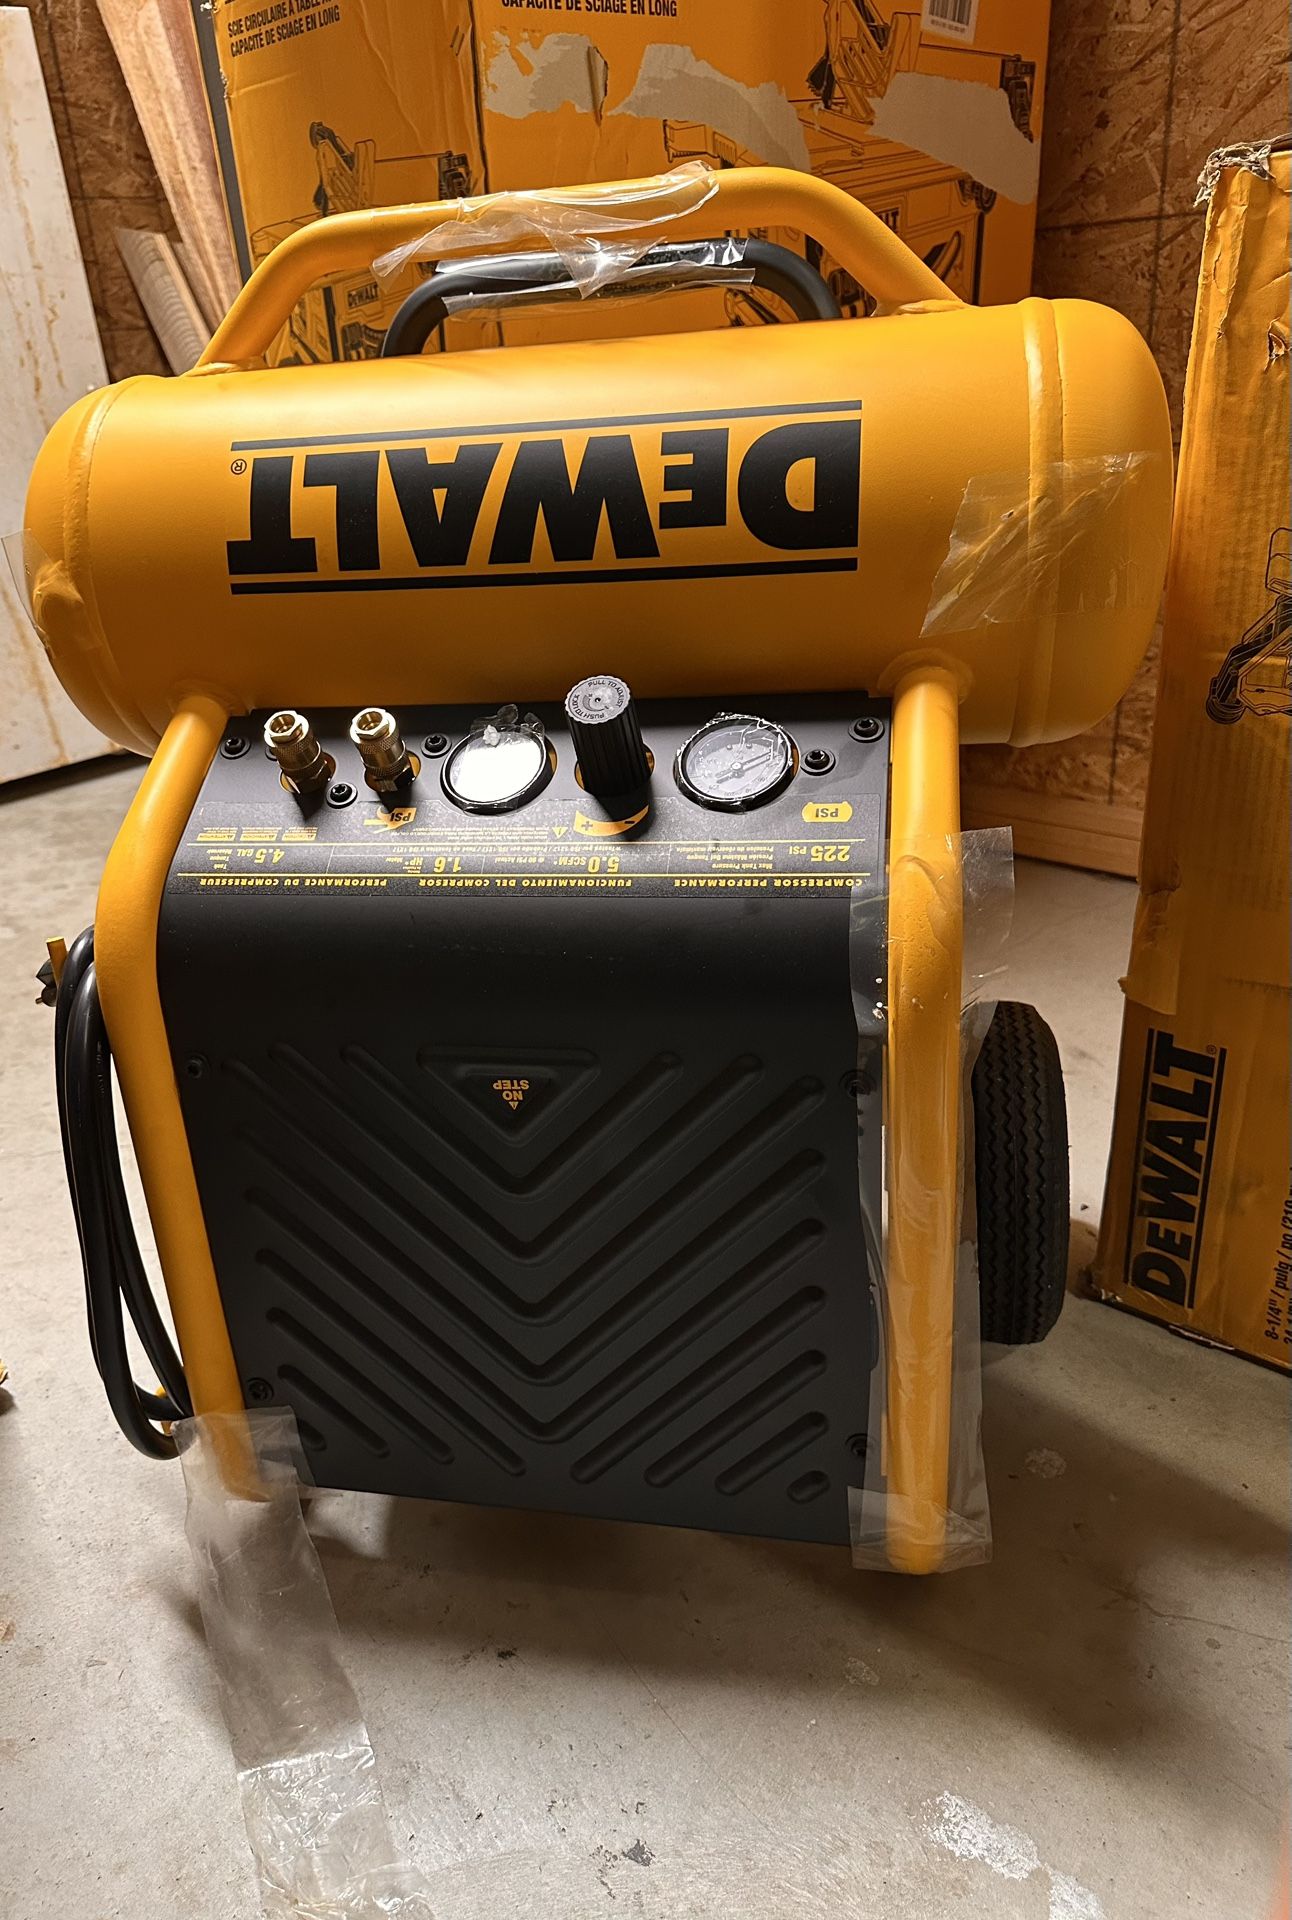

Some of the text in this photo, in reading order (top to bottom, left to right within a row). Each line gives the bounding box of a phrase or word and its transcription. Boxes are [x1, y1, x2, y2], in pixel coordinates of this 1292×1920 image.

[585, 0, 627, 14] SCIAGE
[630, 0, 645, 15] EN
[648, 0, 677, 17] LONG
[228, 18, 244, 38] SCIE
[244, 2, 287, 32] CIRCULAIRE
[230, 4, 340, 57] CAPACITÉ DE SCIAGE EN LONG
[226, 418, 861, 576] DEWALT
[587, 679, 606, 688] PULL
[607, 680, 618, 688] TO
[583, 712, 605, 720] PUSH
[389, 812, 412, 822] PSI
[815, 807, 839, 818] PSI
[236, 849, 285, 864] 4.5 GAL
[789, 845, 851, 862] 225 PSI
[433, 856, 462, 873] 1.6
[588, 856, 620, 873] 5.0
[199, 878, 279, 886] COMPRESSEUR
[495, 879, 516, 887] DEL
[521, 879, 632, 887] FUNCIONAMIENTO
[673, 878, 863, 887] COMPRESSOR PERFORMANCE
[1130, 1029, 1216, 1307] DEWALT
